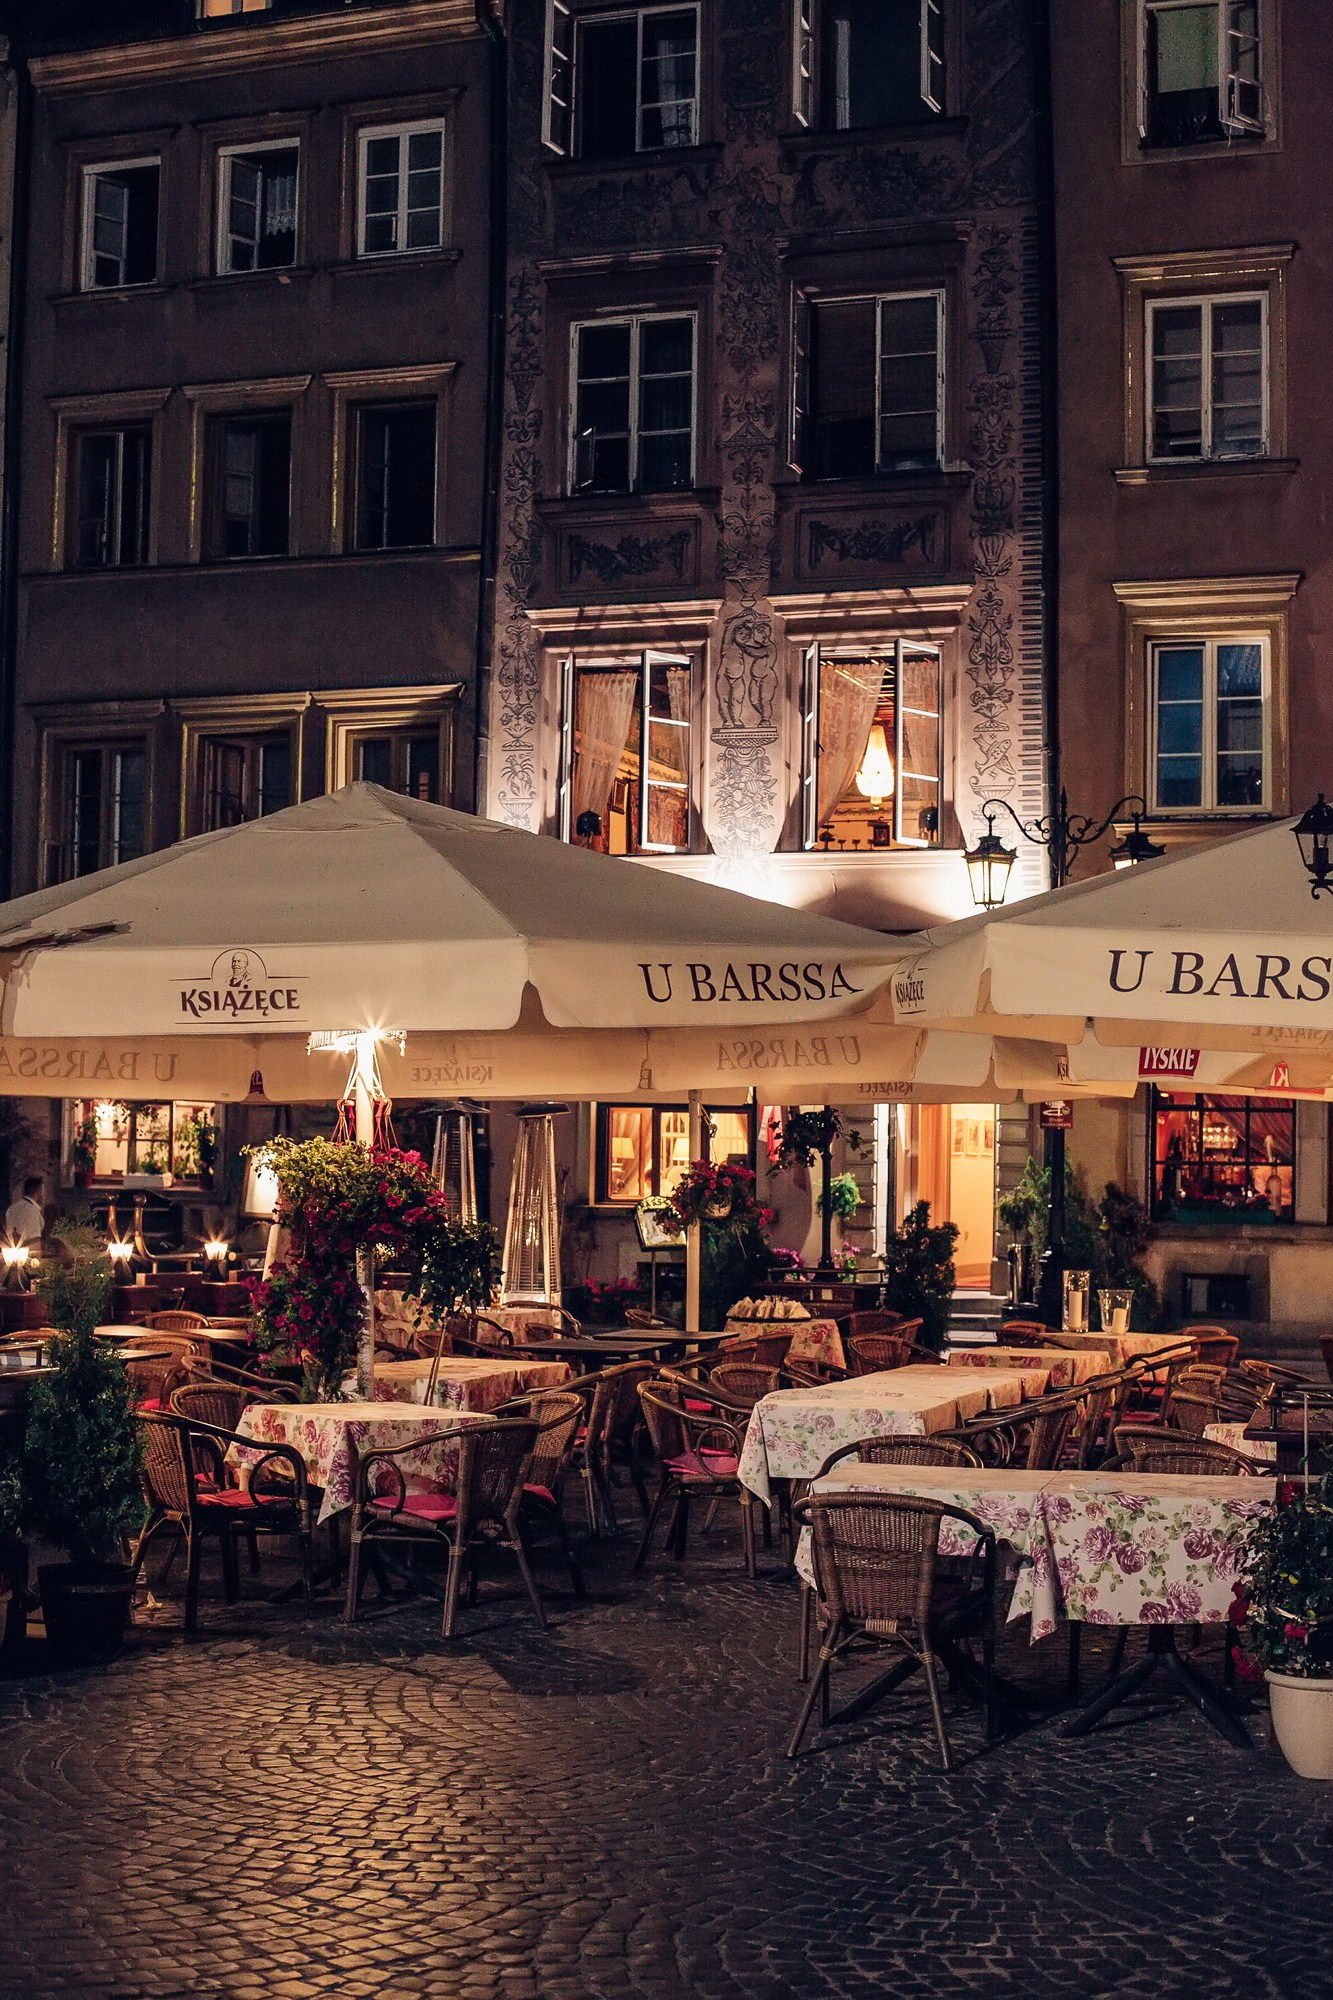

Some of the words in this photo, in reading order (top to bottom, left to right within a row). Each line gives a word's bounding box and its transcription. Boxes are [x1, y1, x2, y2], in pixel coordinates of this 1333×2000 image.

[638, 963, 673, 1003] U
[686, 962, 864, 1002] BARSSA
[1109, 949, 1153, 993] U
[180, 983, 300, 1018] KSIĄŻĘCE
